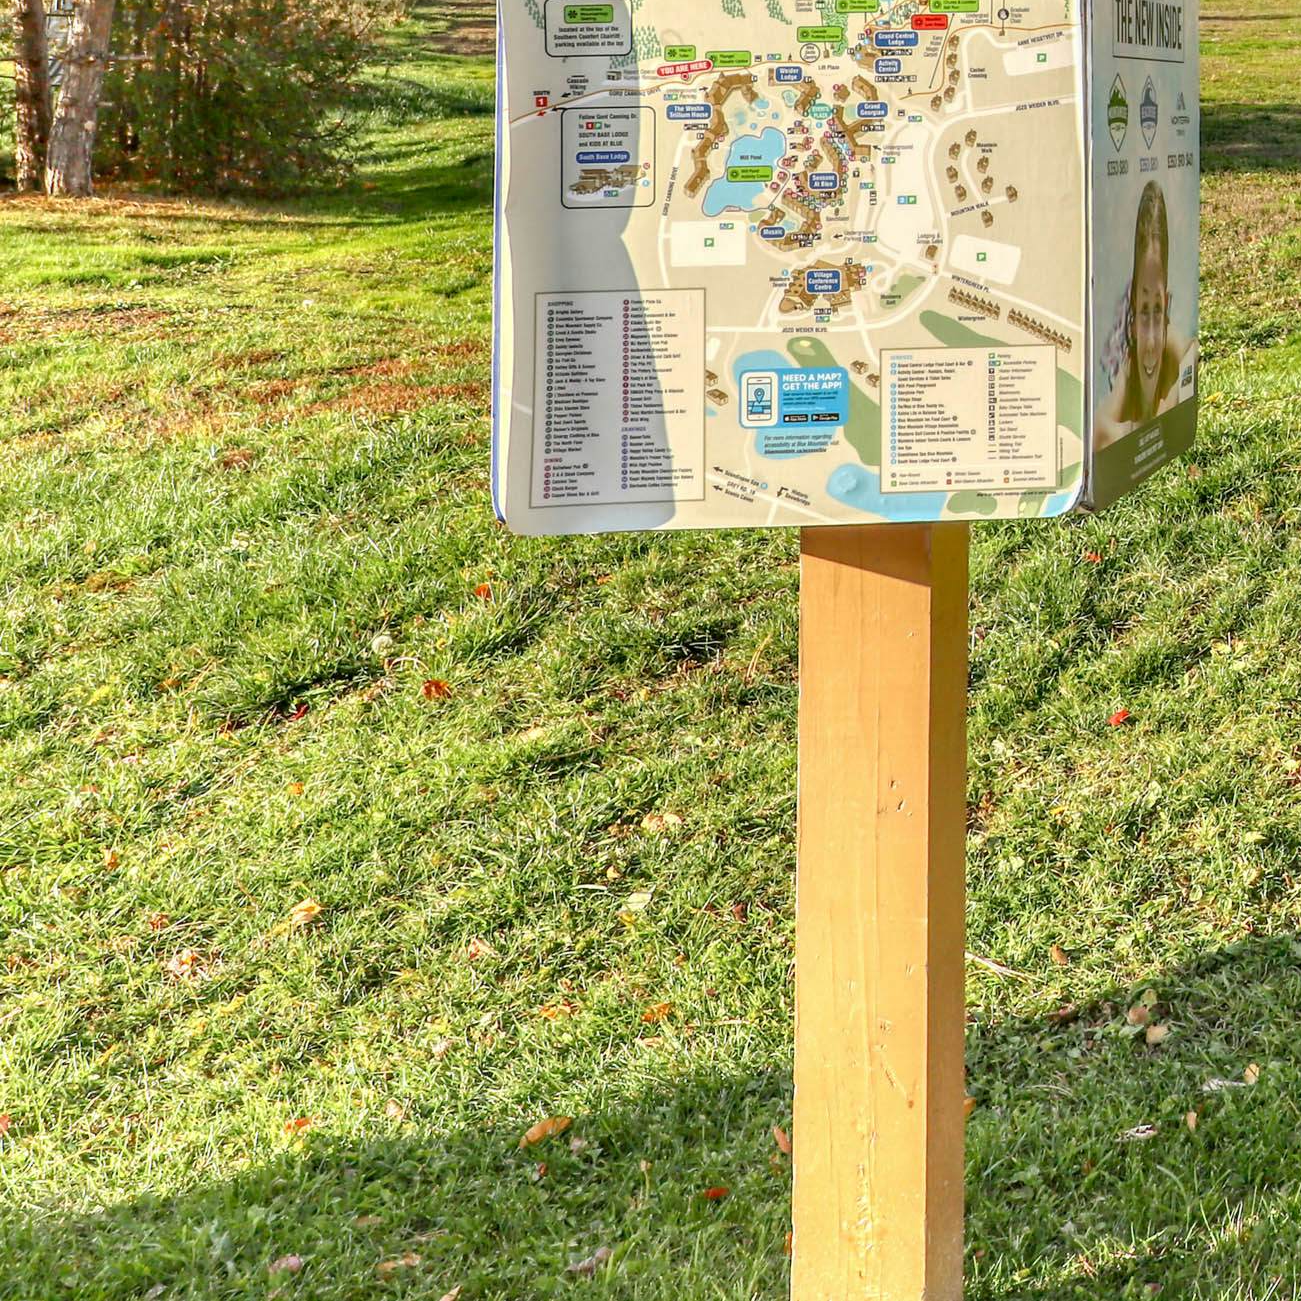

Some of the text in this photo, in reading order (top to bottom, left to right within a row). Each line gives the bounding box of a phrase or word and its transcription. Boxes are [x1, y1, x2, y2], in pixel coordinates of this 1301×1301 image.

[1135, 0, 1153, 46] NEW
[1156, 3, 1182, 49] INSIDE
[661, 62, 707, 74] YOU ARE HERE
[610, 153, 627, 161] Lodge
[951, 201, 989, 217] MOUNTAIN WALK
[783, 374, 805, 382] NEED
[817, 373, 842, 381] MAP?
[783, 381, 842, 390] GET THE APP!
